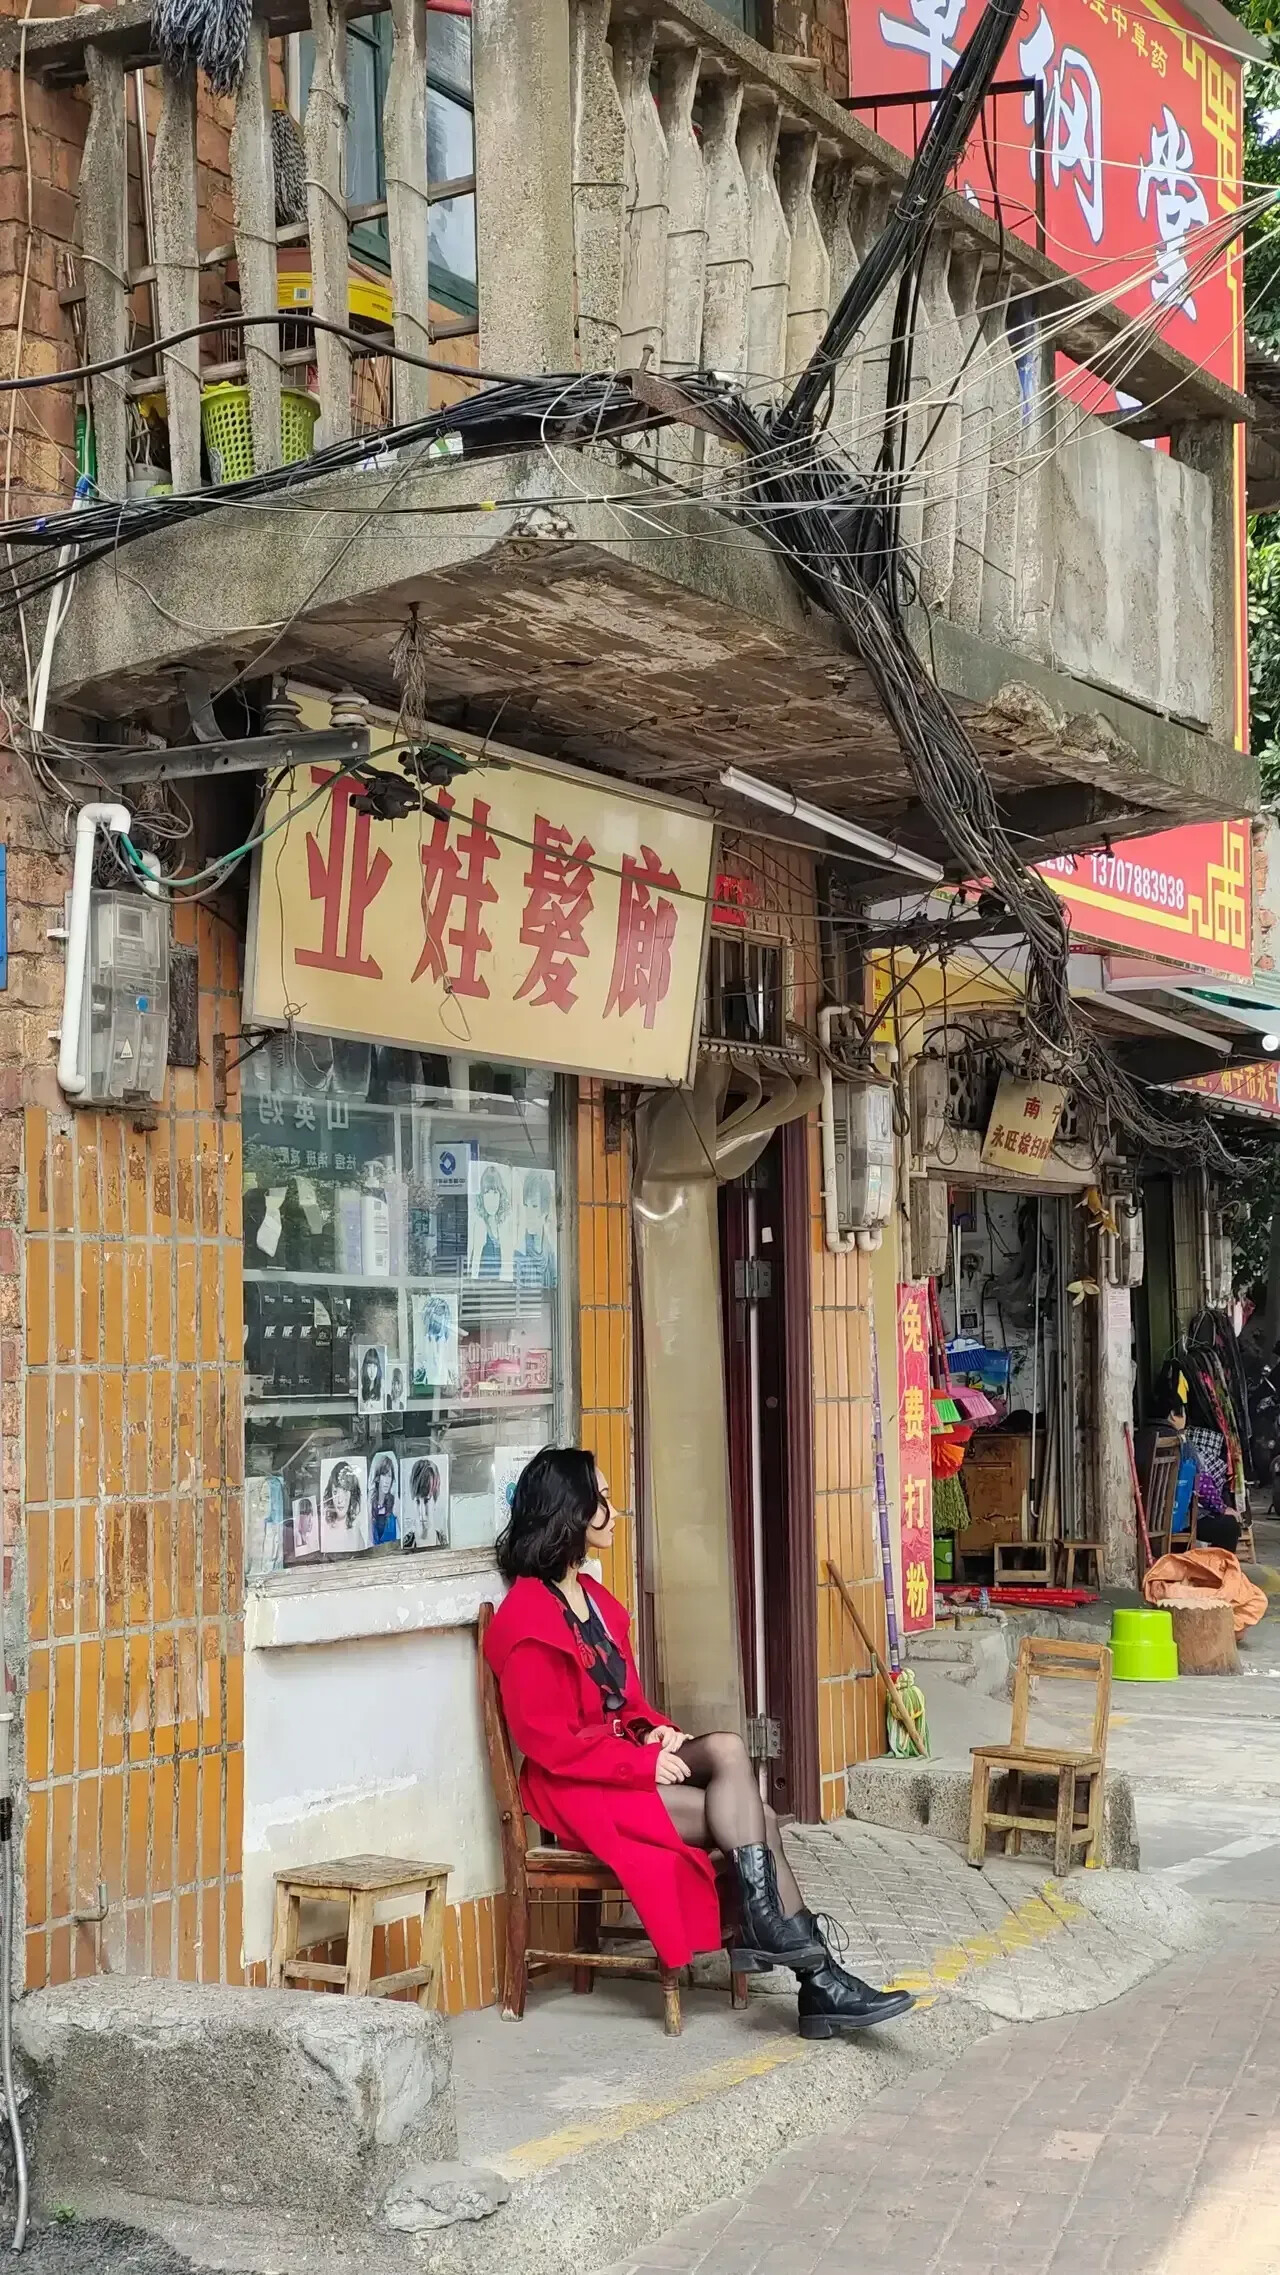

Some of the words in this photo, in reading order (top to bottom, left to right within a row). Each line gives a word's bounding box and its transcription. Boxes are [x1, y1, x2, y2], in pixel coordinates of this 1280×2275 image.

[1090, 852, 1185, 911] 13707883938
[902, 1297, 929, 1620] 免费打粉
